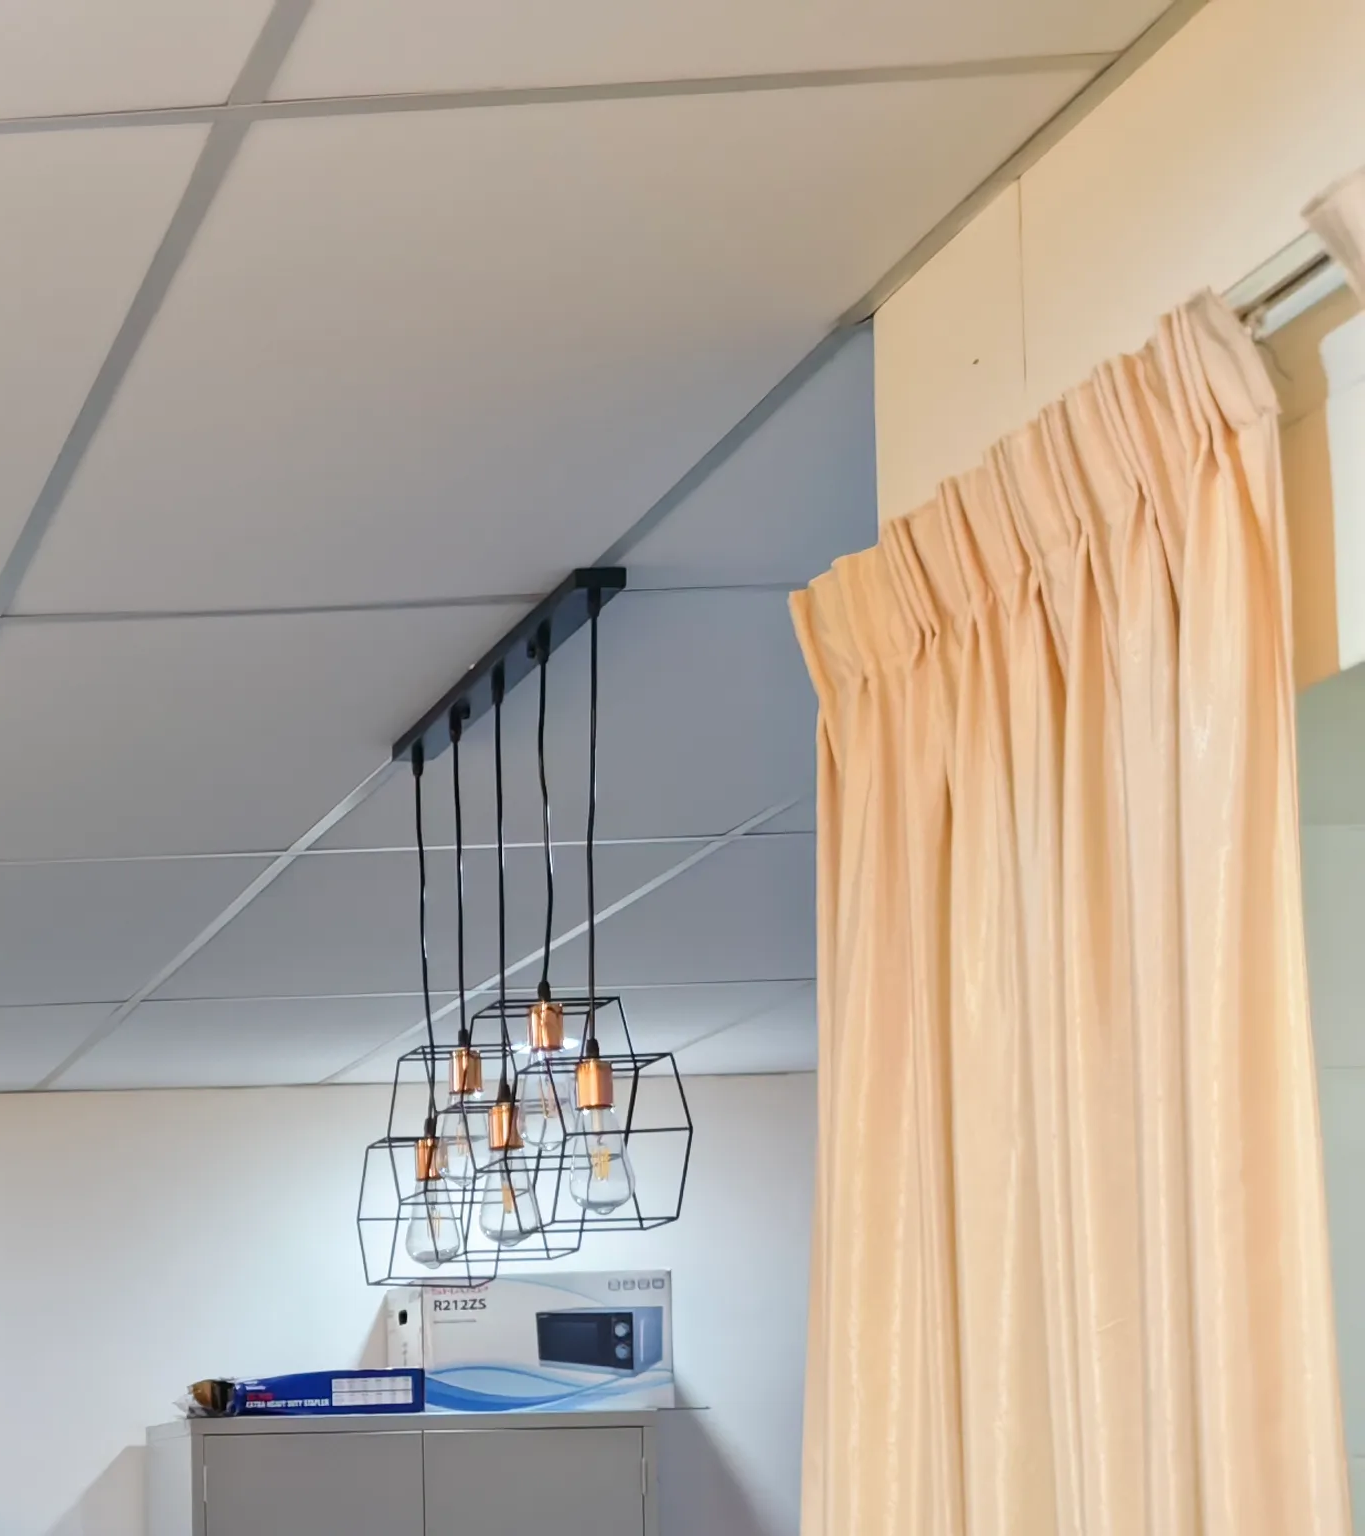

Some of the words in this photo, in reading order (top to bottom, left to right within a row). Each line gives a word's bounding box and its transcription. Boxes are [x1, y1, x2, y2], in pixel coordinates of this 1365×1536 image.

[433, 1298, 487, 1312] R212ZS
[245, 1400, 266, 1409] EXTRA
[303, 1398, 330, 1407] STAPLER
